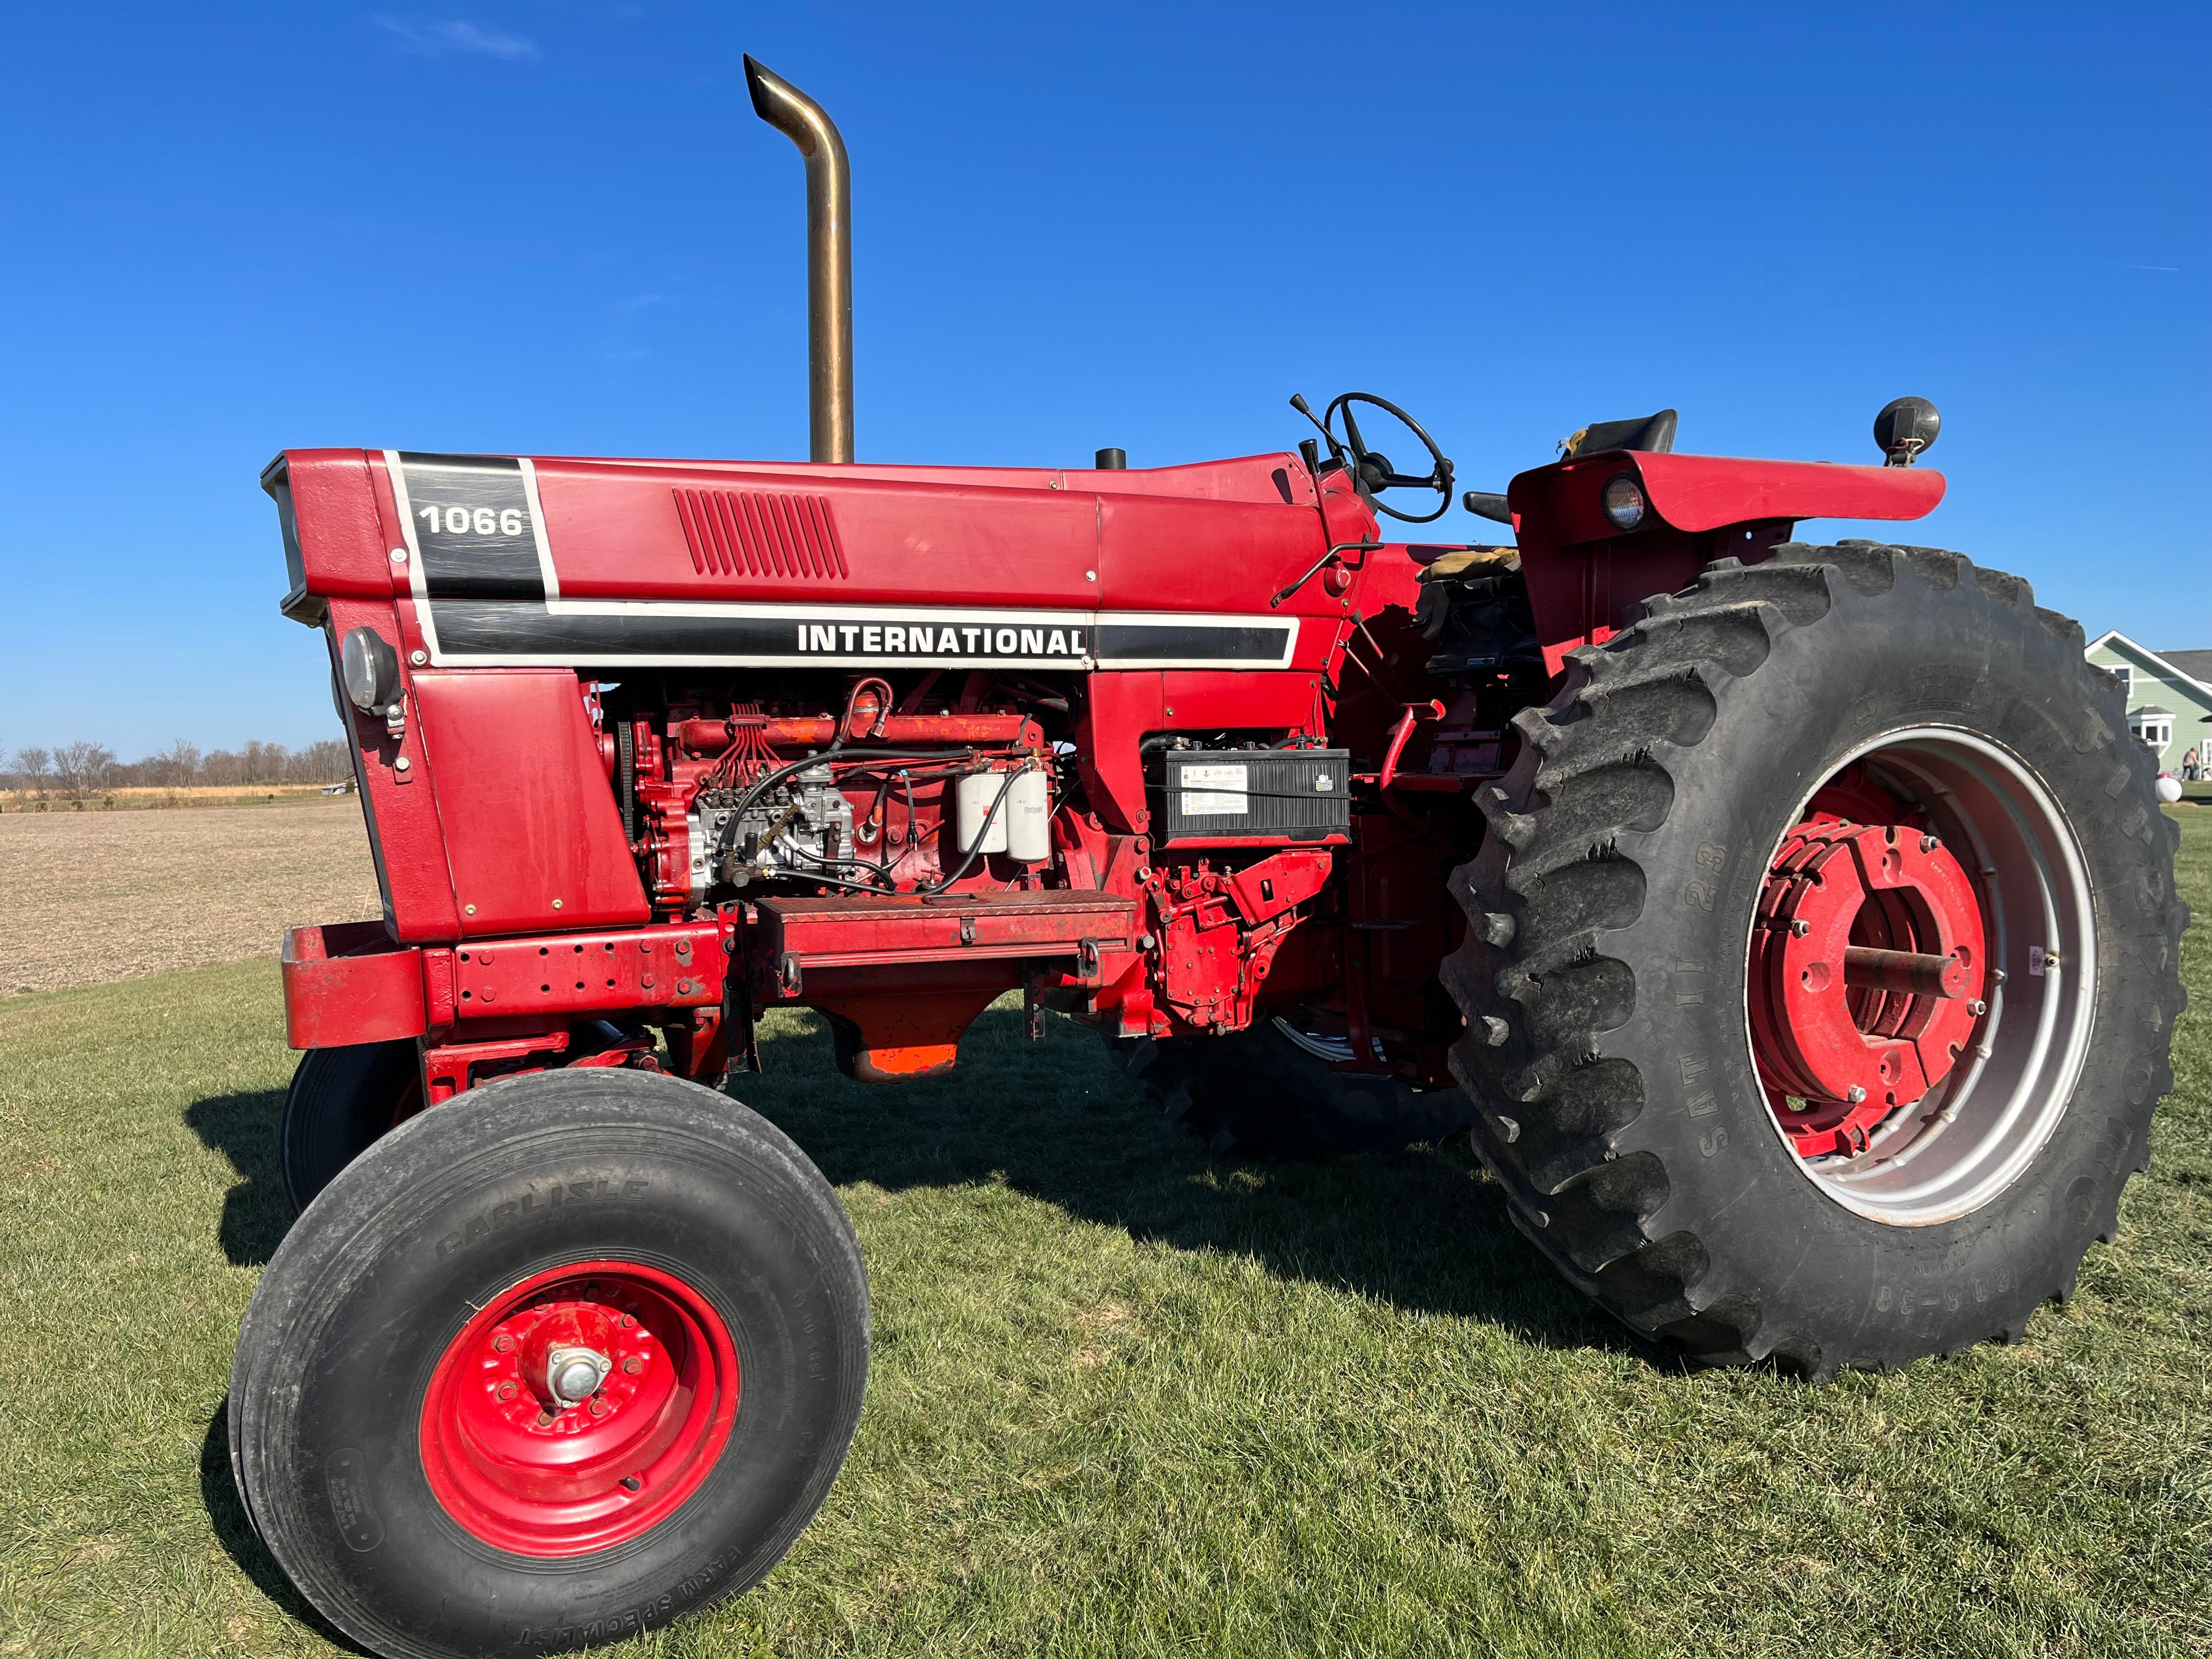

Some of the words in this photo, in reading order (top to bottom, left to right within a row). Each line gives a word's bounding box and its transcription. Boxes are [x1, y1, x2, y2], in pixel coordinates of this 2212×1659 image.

[419, 506, 523, 536] 1066
[798, 624, 1087, 655] INTERNATIONAL
[2066, 706, 2168, 1226] Firestone
[1678, 1054, 1729, 1159] SAT
[435, 1179, 650, 1263] CARLISLE
[1876, 1263, 2010, 1317] 20.8-38
[678, 1544, 743, 1599] FARM
[516, 1595, 674, 1646] SPECIALIST
